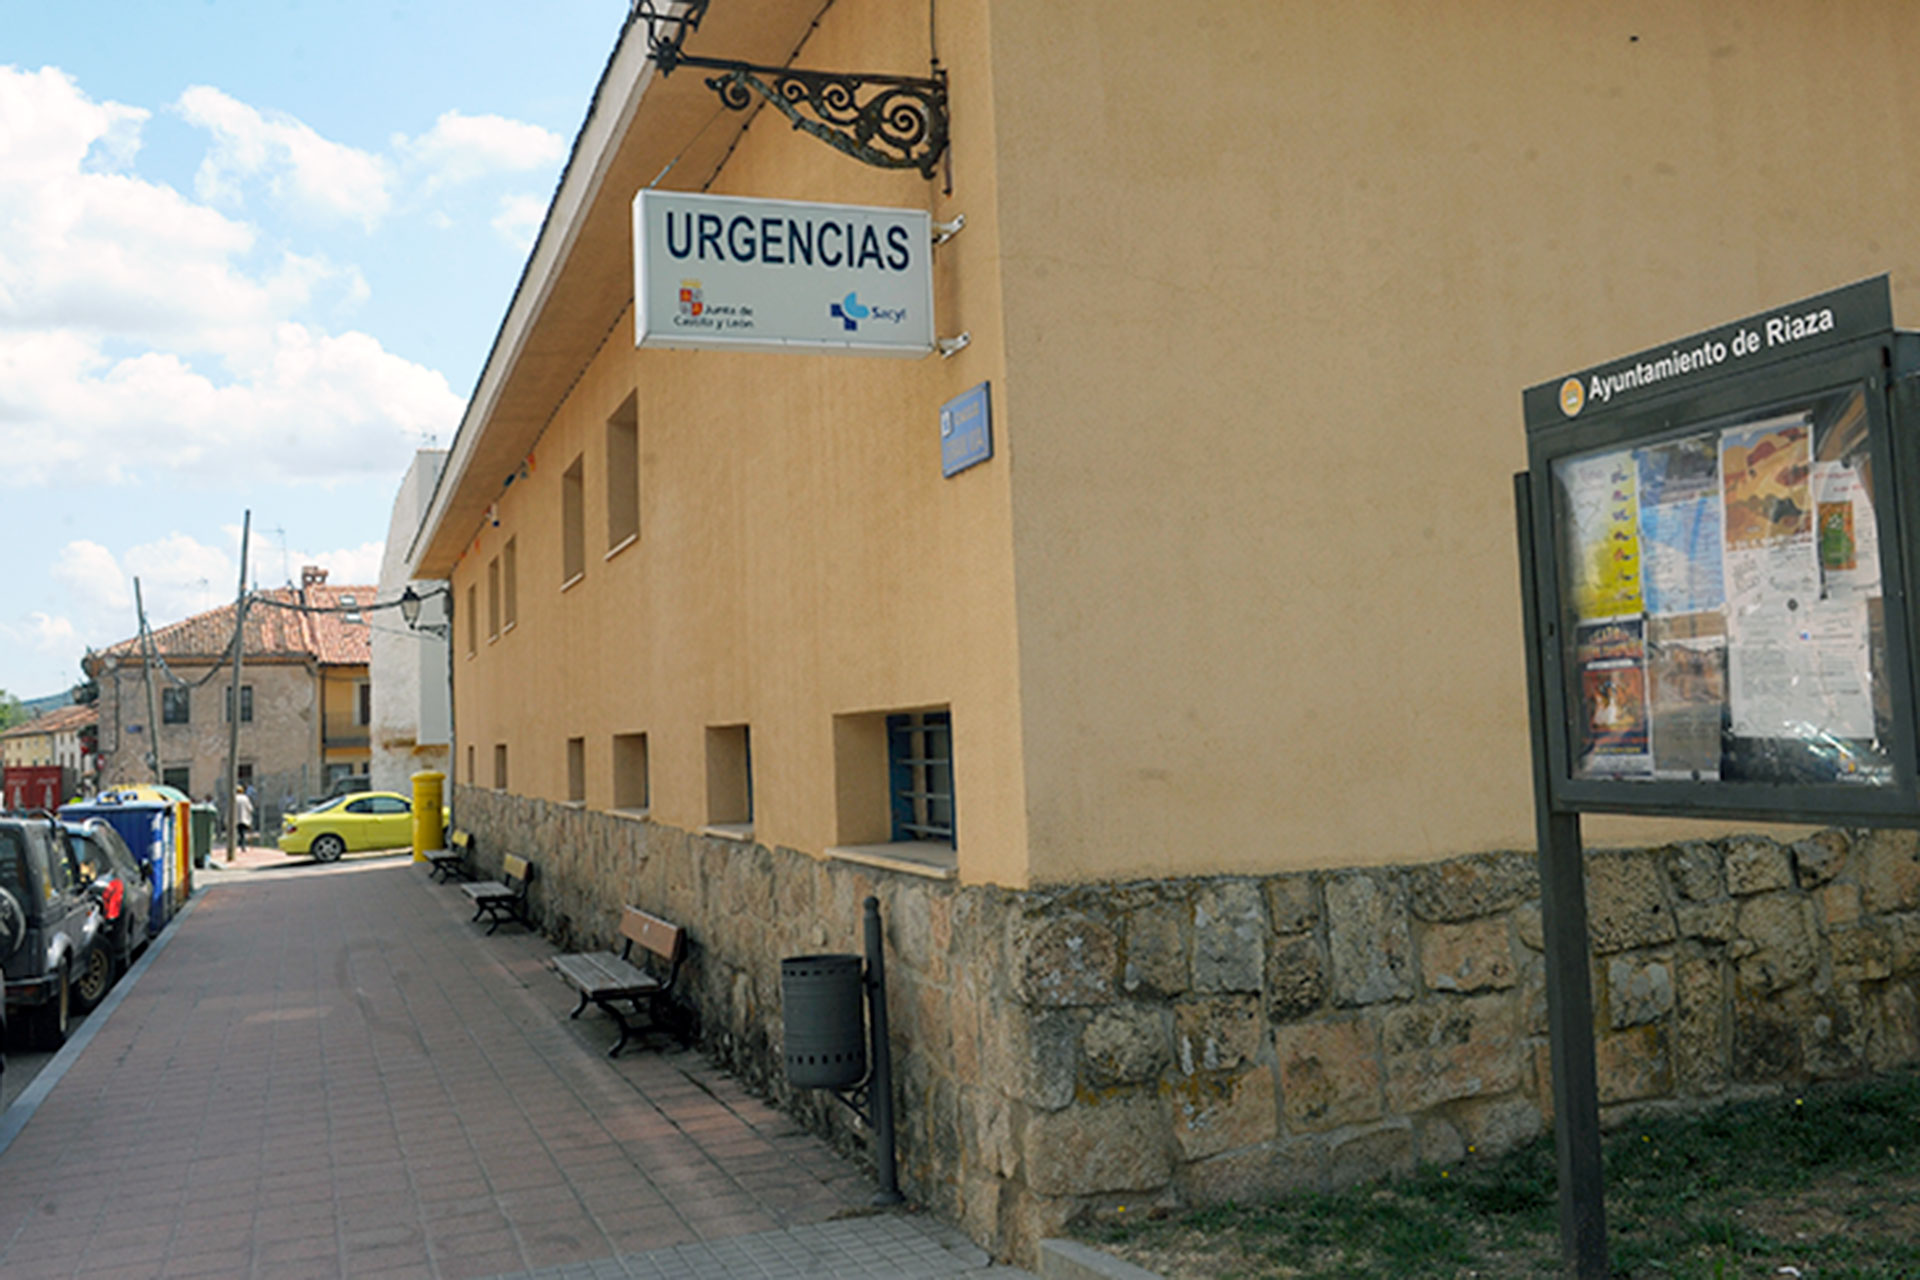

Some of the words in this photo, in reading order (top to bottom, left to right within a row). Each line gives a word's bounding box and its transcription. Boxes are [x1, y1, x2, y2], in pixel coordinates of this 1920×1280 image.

[666, 211, 910, 271] URGENCIAS
[1588, 340, 1728, 402] Ayuntamiento
[1731, 329, 1761, 358] de
[1765, 308, 1835, 348] Riaza
